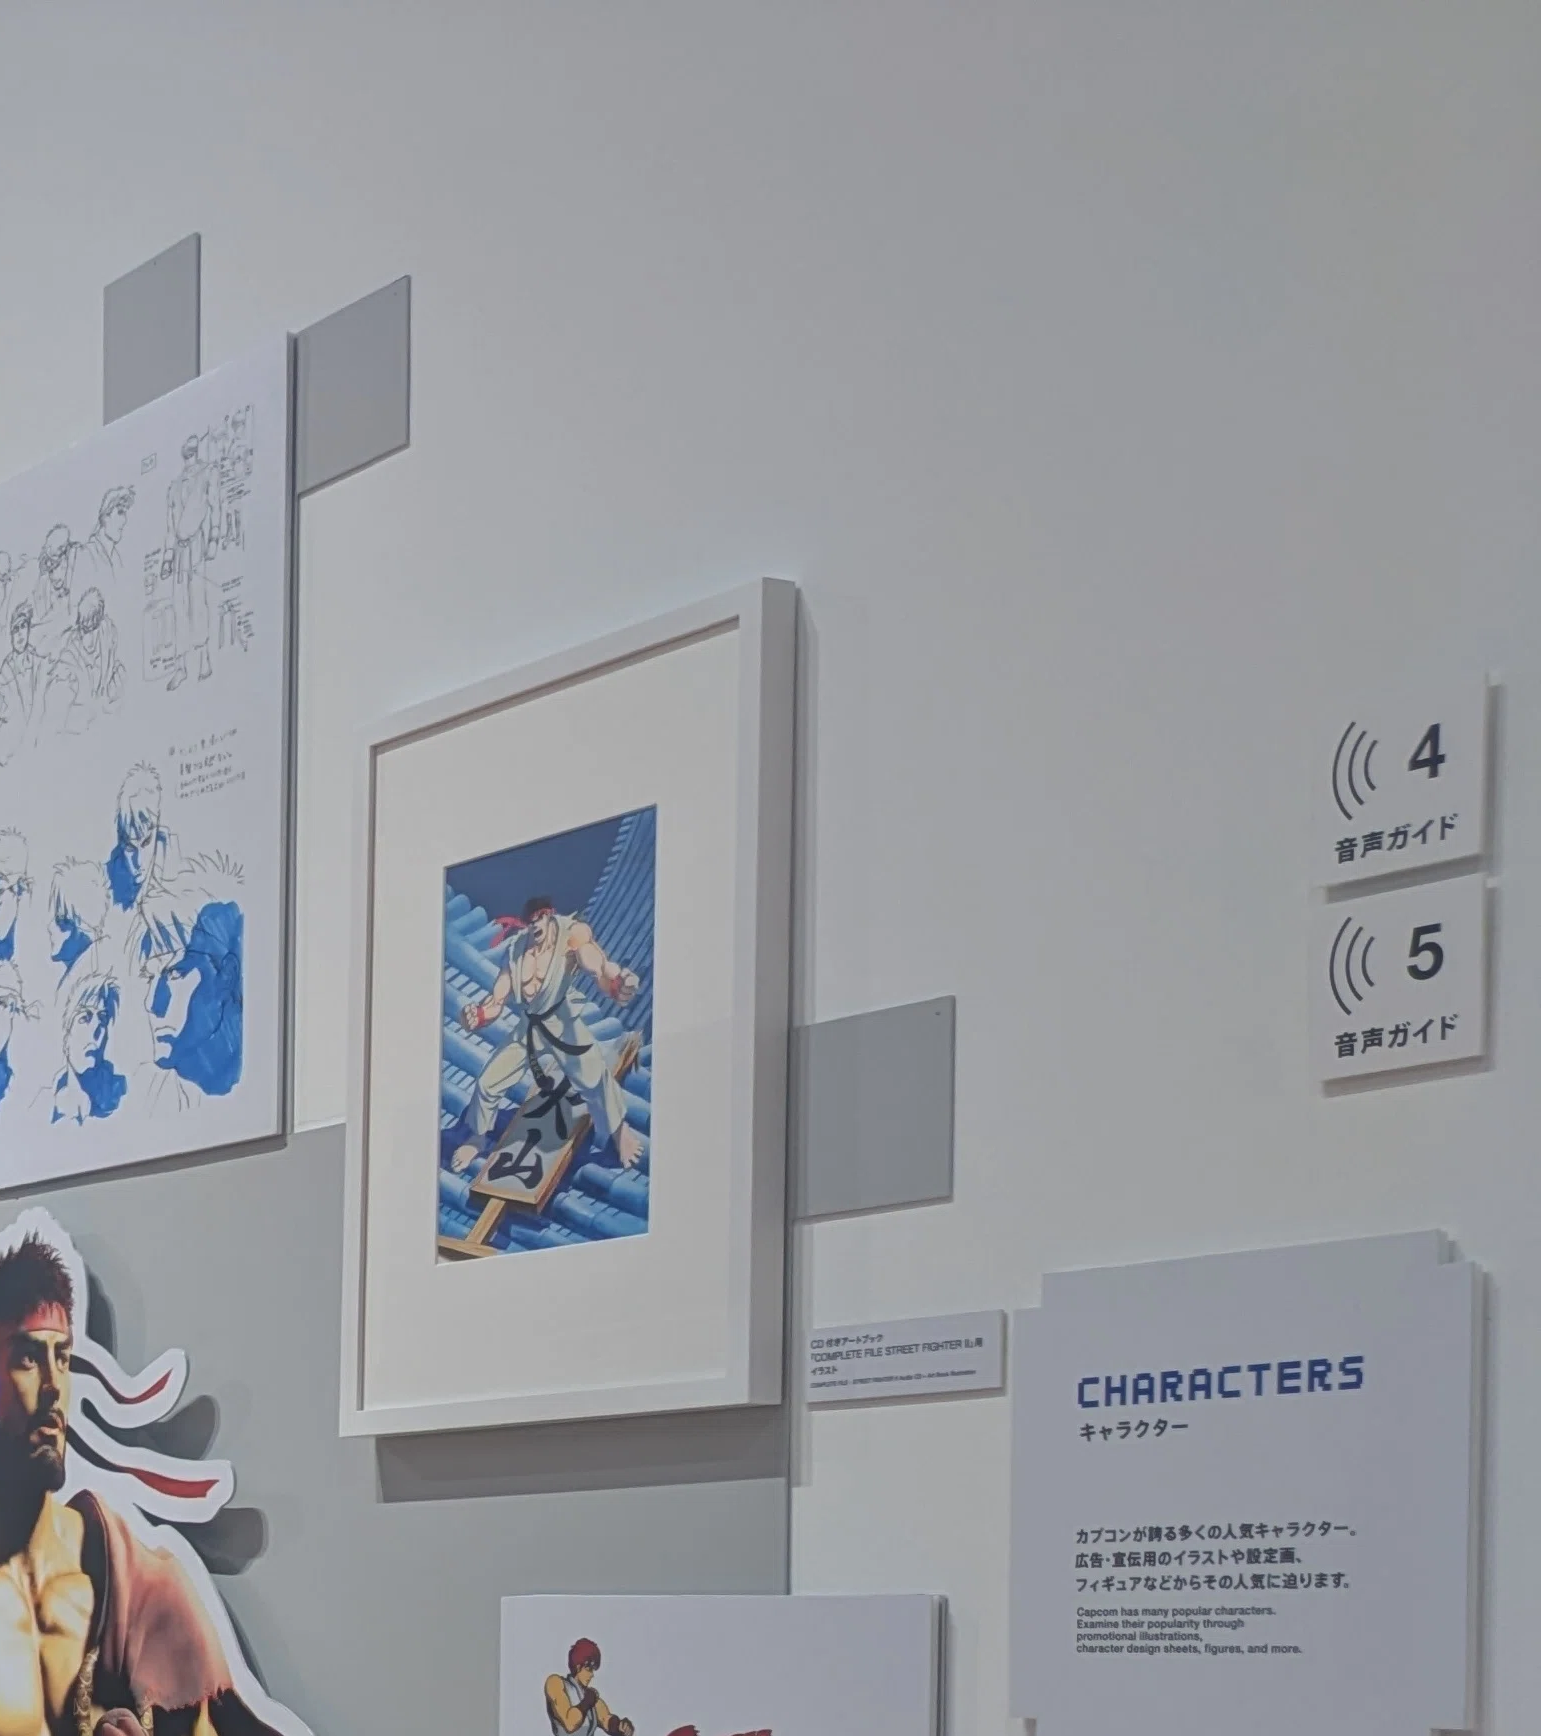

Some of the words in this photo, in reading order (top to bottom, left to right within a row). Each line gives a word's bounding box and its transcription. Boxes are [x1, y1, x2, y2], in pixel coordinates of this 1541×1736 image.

[1408, 723, 1446, 779] 4
[1335, 813, 1459, 864] 音声ガイド
[1407, 923, 1444, 981] 5
[1334, 1014, 1459, 1058] 音声ガイド
[864, 1347, 884, 1357] FILE
[885, 1343, 920, 1356] STREET
[922, 1340, 962, 1352] FIGHTER
[1077, 1355, 1364, 1409] CHARACTERS
[1079, 1418, 1189, 1442] キャラクター
[1076, 1520, 1358, 1544] カプコンが誇る多くの人気キャラクター。
[1074, 1547, 1302, 1569] 広告・宣伝用のイラストや設定画、
[1075, 1571, 1351, 1593] フィギュアなどからその人気に迫ります。
[1076, 1607, 1118, 1619] Capcom
[1121, 1606, 1139, 1617] has
[1141, 1608, 1169, 1619] many
[1172, 1606, 1213, 1618] popular
[1215, 1606, 1276, 1616] characters.
[1076, 1619, 1119, 1629] Examine
[1121, 1619, 1144, 1629] their
[1147, 1619, 1200, 1631] popularity
[1203, 1618, 1245, 1630] through
[1076, 1631, 1136, 1643] promotional
[1139, 1631, 1203, 1643] illustrations,
[1076, 1644, 1124, 1654] character
[1126, 1644, 1161, 1656] design
[1163, 1644, 1202, 1655] sheets,
[1204, 1644, 1244, 1655] figures,
[1247, 1644, 1268, 1654] and
[1271, 1645, 1302, 1654] more.
